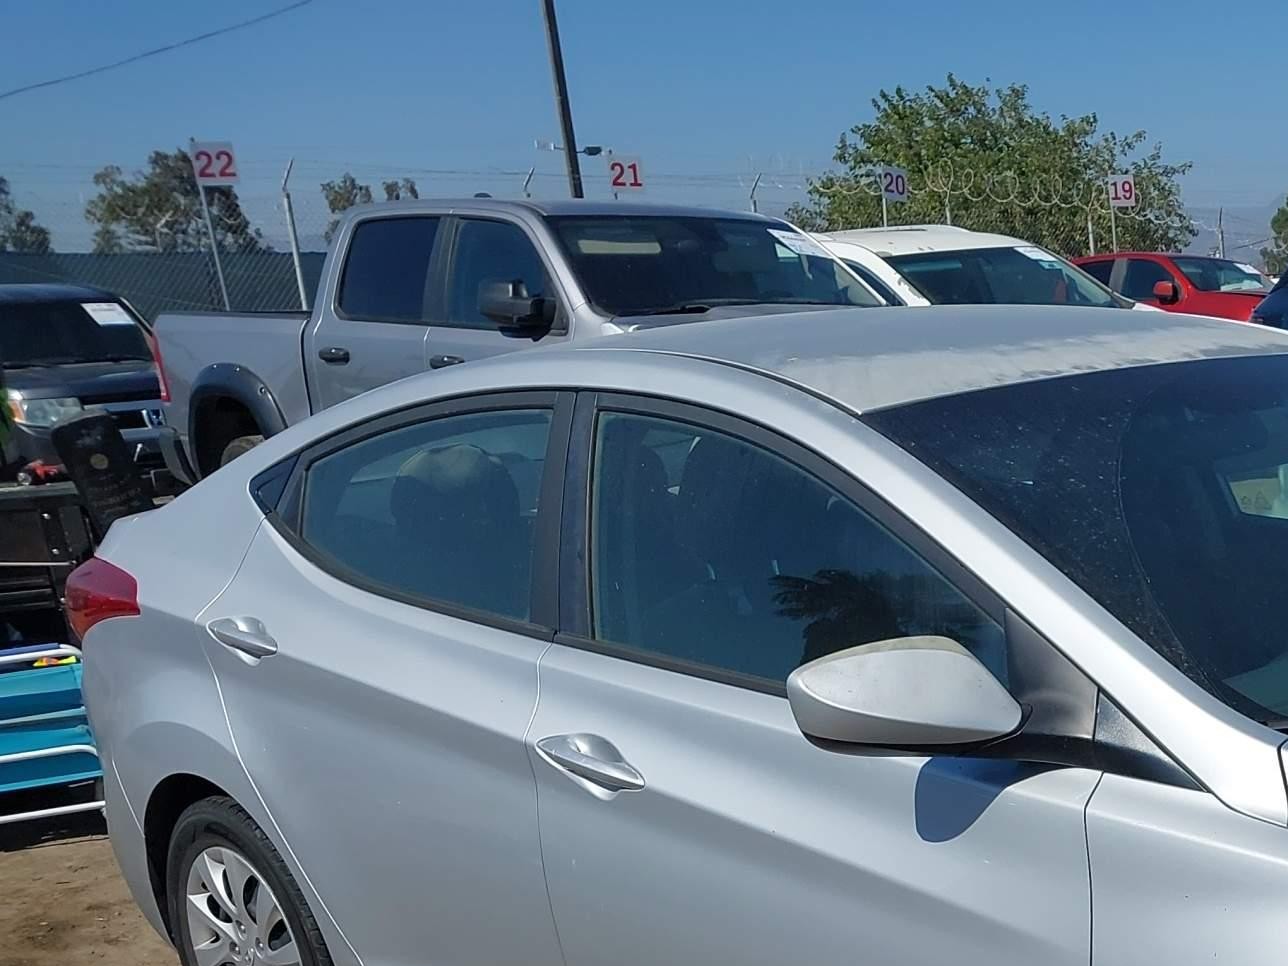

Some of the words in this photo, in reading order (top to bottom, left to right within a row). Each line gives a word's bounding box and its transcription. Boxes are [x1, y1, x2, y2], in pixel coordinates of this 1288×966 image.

[195, 150, 236, 177] 22
[610, 162, 642, 187] 21
[884, 172, 905, 195] 20
[1111, 181, 1132, 200] 19
